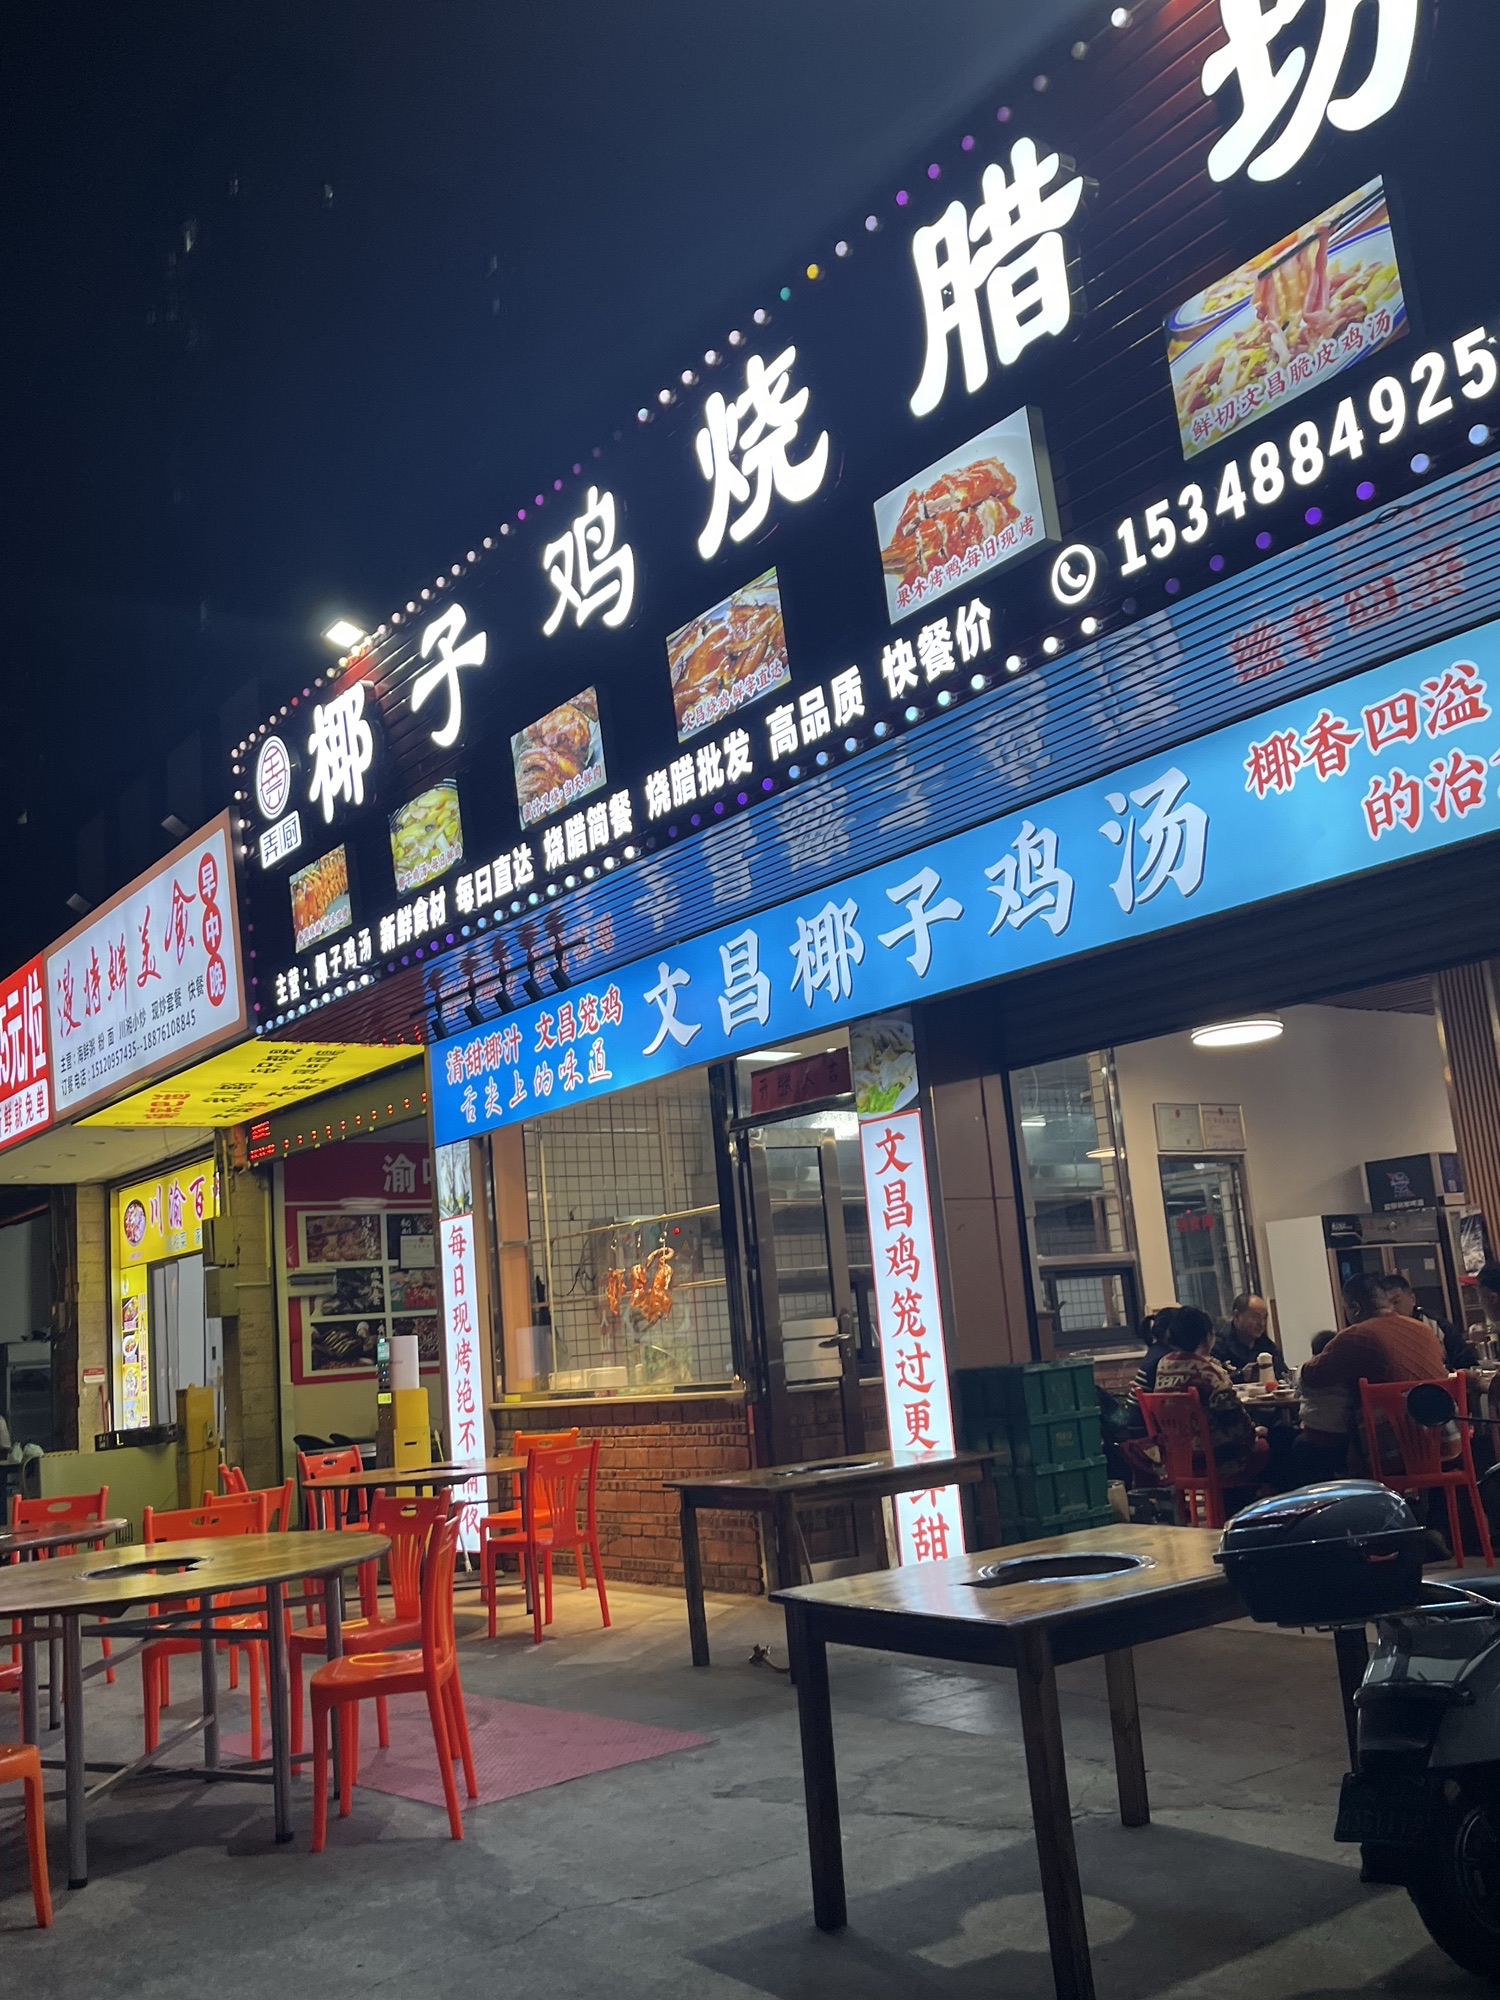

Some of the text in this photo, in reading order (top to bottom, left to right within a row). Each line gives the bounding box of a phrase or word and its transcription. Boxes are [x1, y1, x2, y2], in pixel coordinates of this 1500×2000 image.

[1117, 325, 1498, 577] 1534884925
[379, 885, 447, 954] 新鲜食材
[455, 842, 535, 915] 每日直达
[542, 788, 634, 872] 烧腊简餐
[645, 727, 754, 821] 烧腊批发
[764, 664, 867, 763] 高品质
[881, 596, 992, 699] 快餐价
[1246, 662, 1489, 797] 椰香四溢
[1362, 750, 1500, 839] 的治
[201, 861, 225, 998] 早中晚
[641, 766, 1210, 1057] 文昌椰子鸡汤
[188, 974, 204, 1002] 快餐
[446, 983, 624, 1087] 清甜椰汁 文昌笼鸡
[0, 1084, 46, 1138] 鲜就免单
[459, 1038, 614, 1125] 舌尖上的味道
[150, 1171, 220, 1235] 川渝百
[873, 1128, 950, 1562] 文昌鸡笼过更甜
